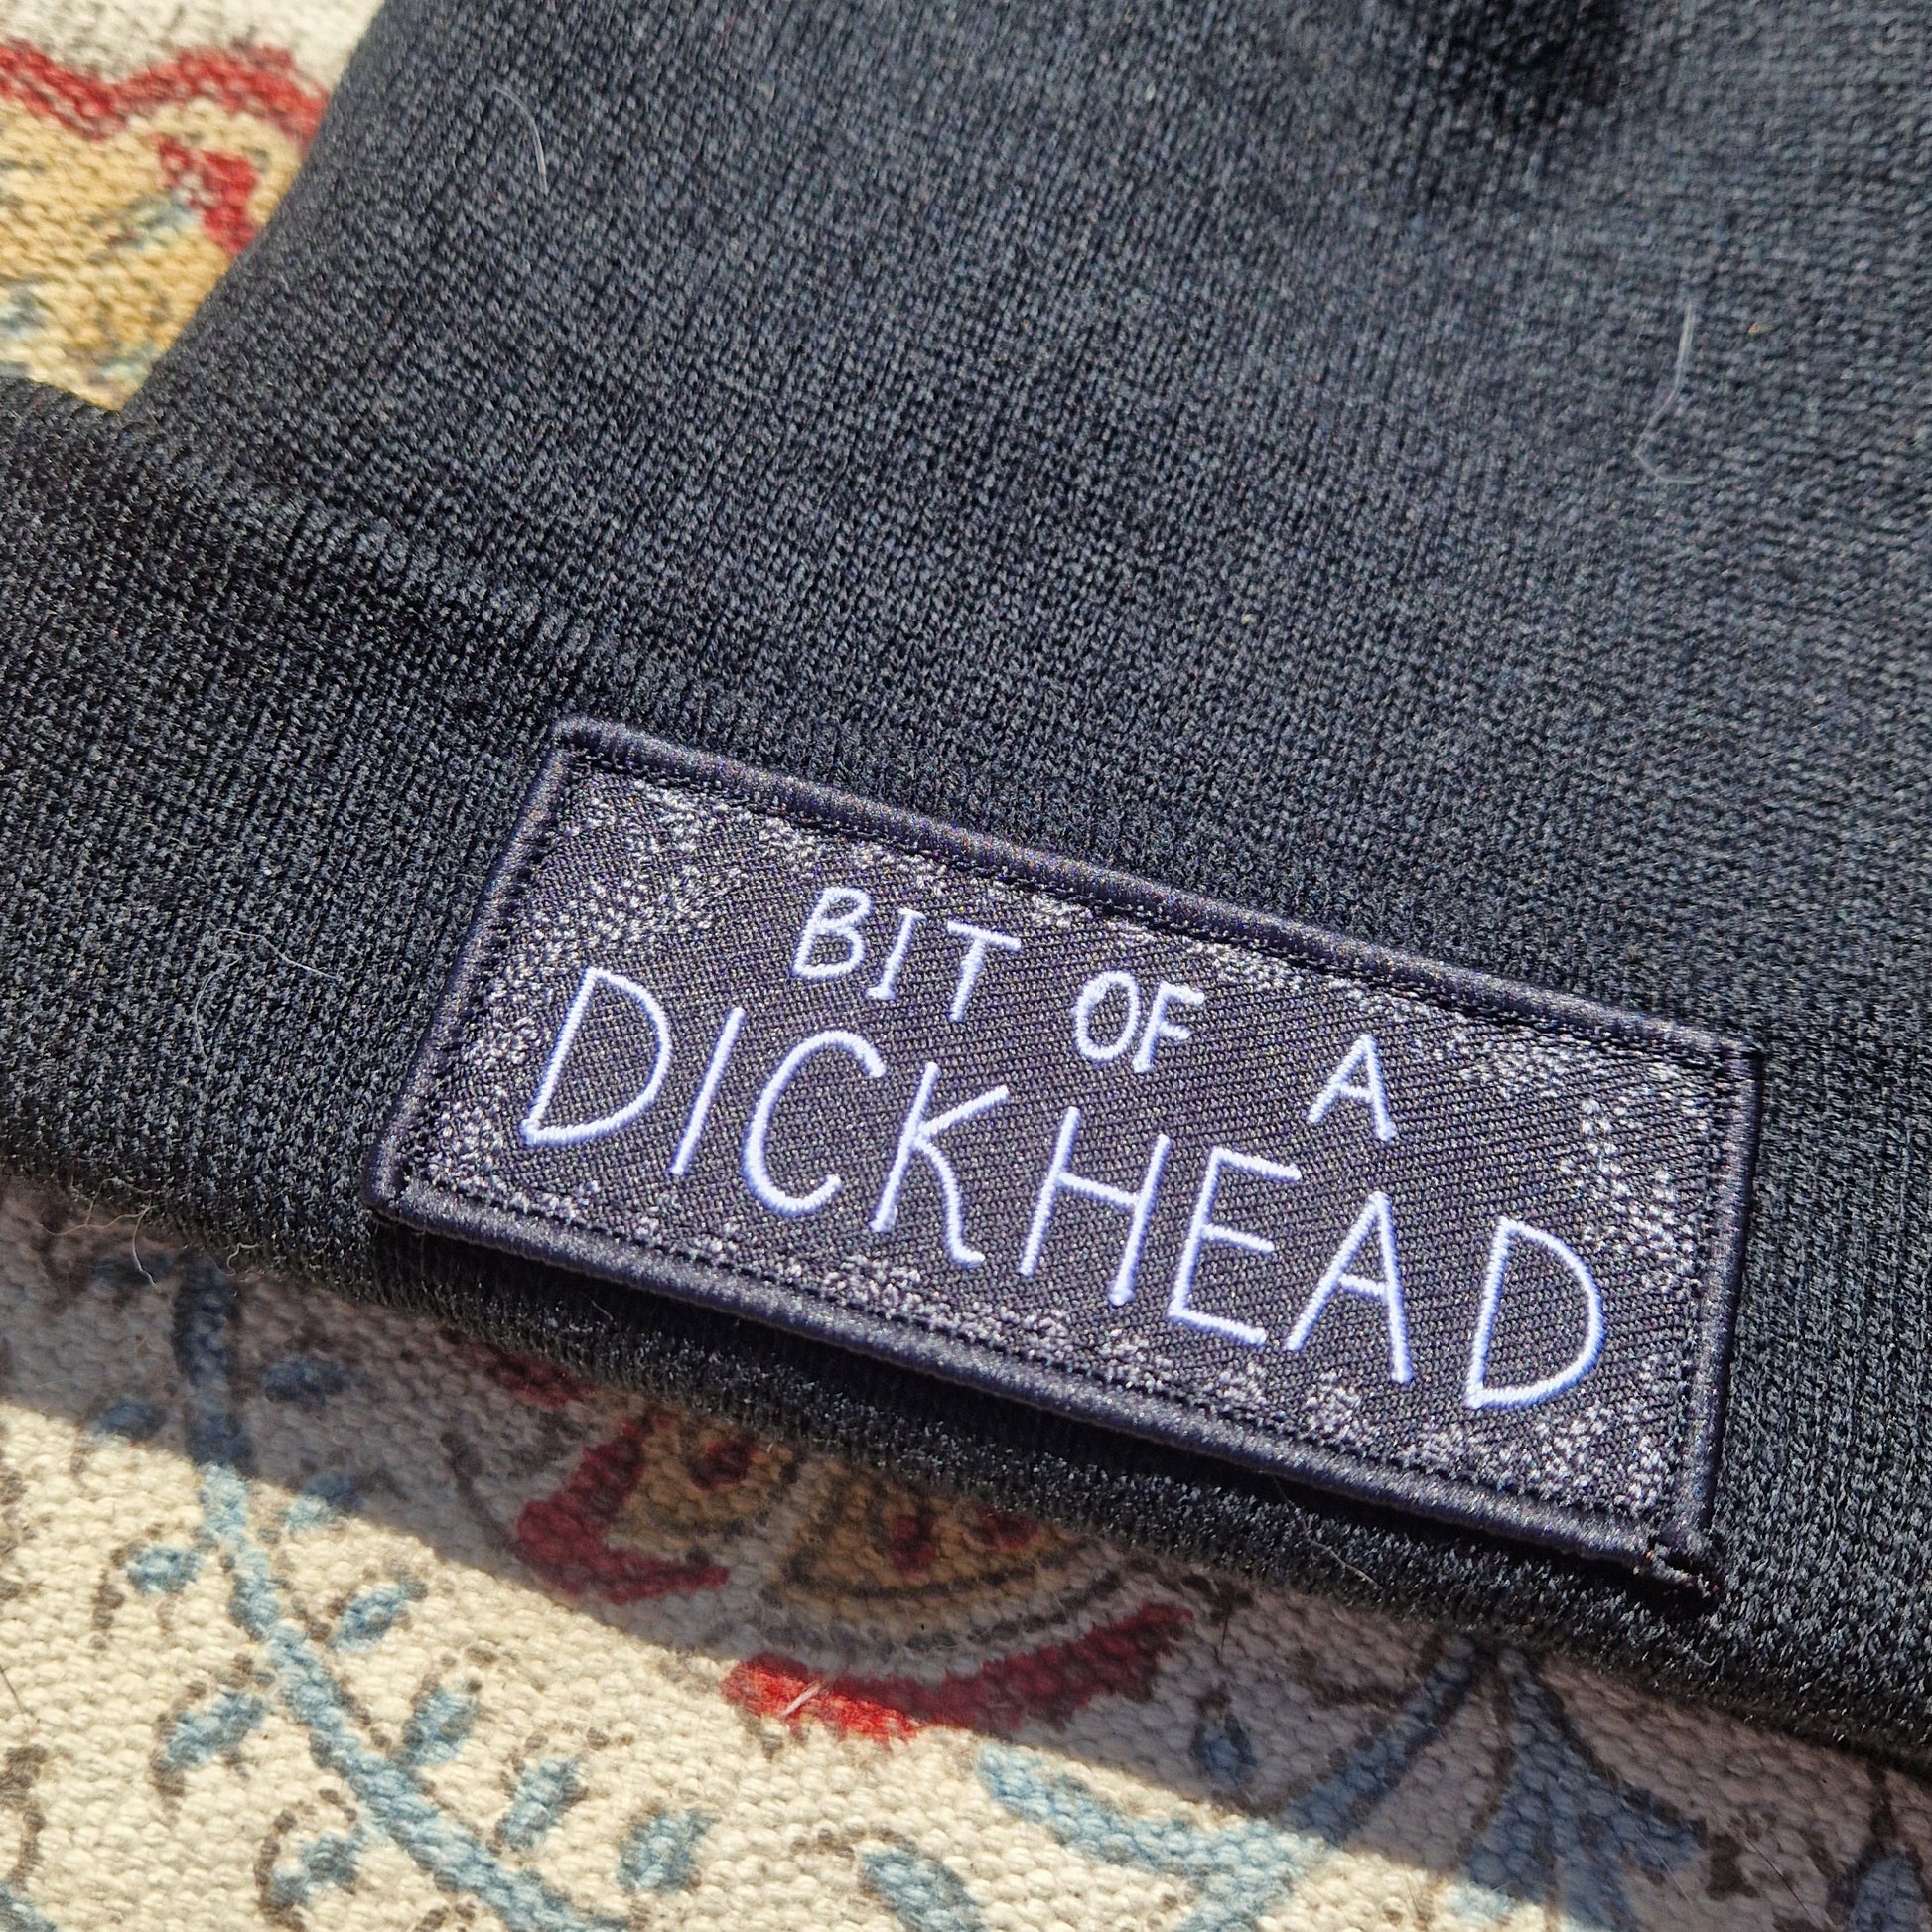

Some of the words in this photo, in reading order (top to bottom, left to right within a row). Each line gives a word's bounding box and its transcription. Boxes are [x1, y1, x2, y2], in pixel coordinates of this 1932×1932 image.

[521, 967, 1603, 1408] DICKHEAD
[791, 886, 1022, 1023] BIT
[1073, 971, 1205, 1072] OF
[1307, 1035, 1395, 1143] A
